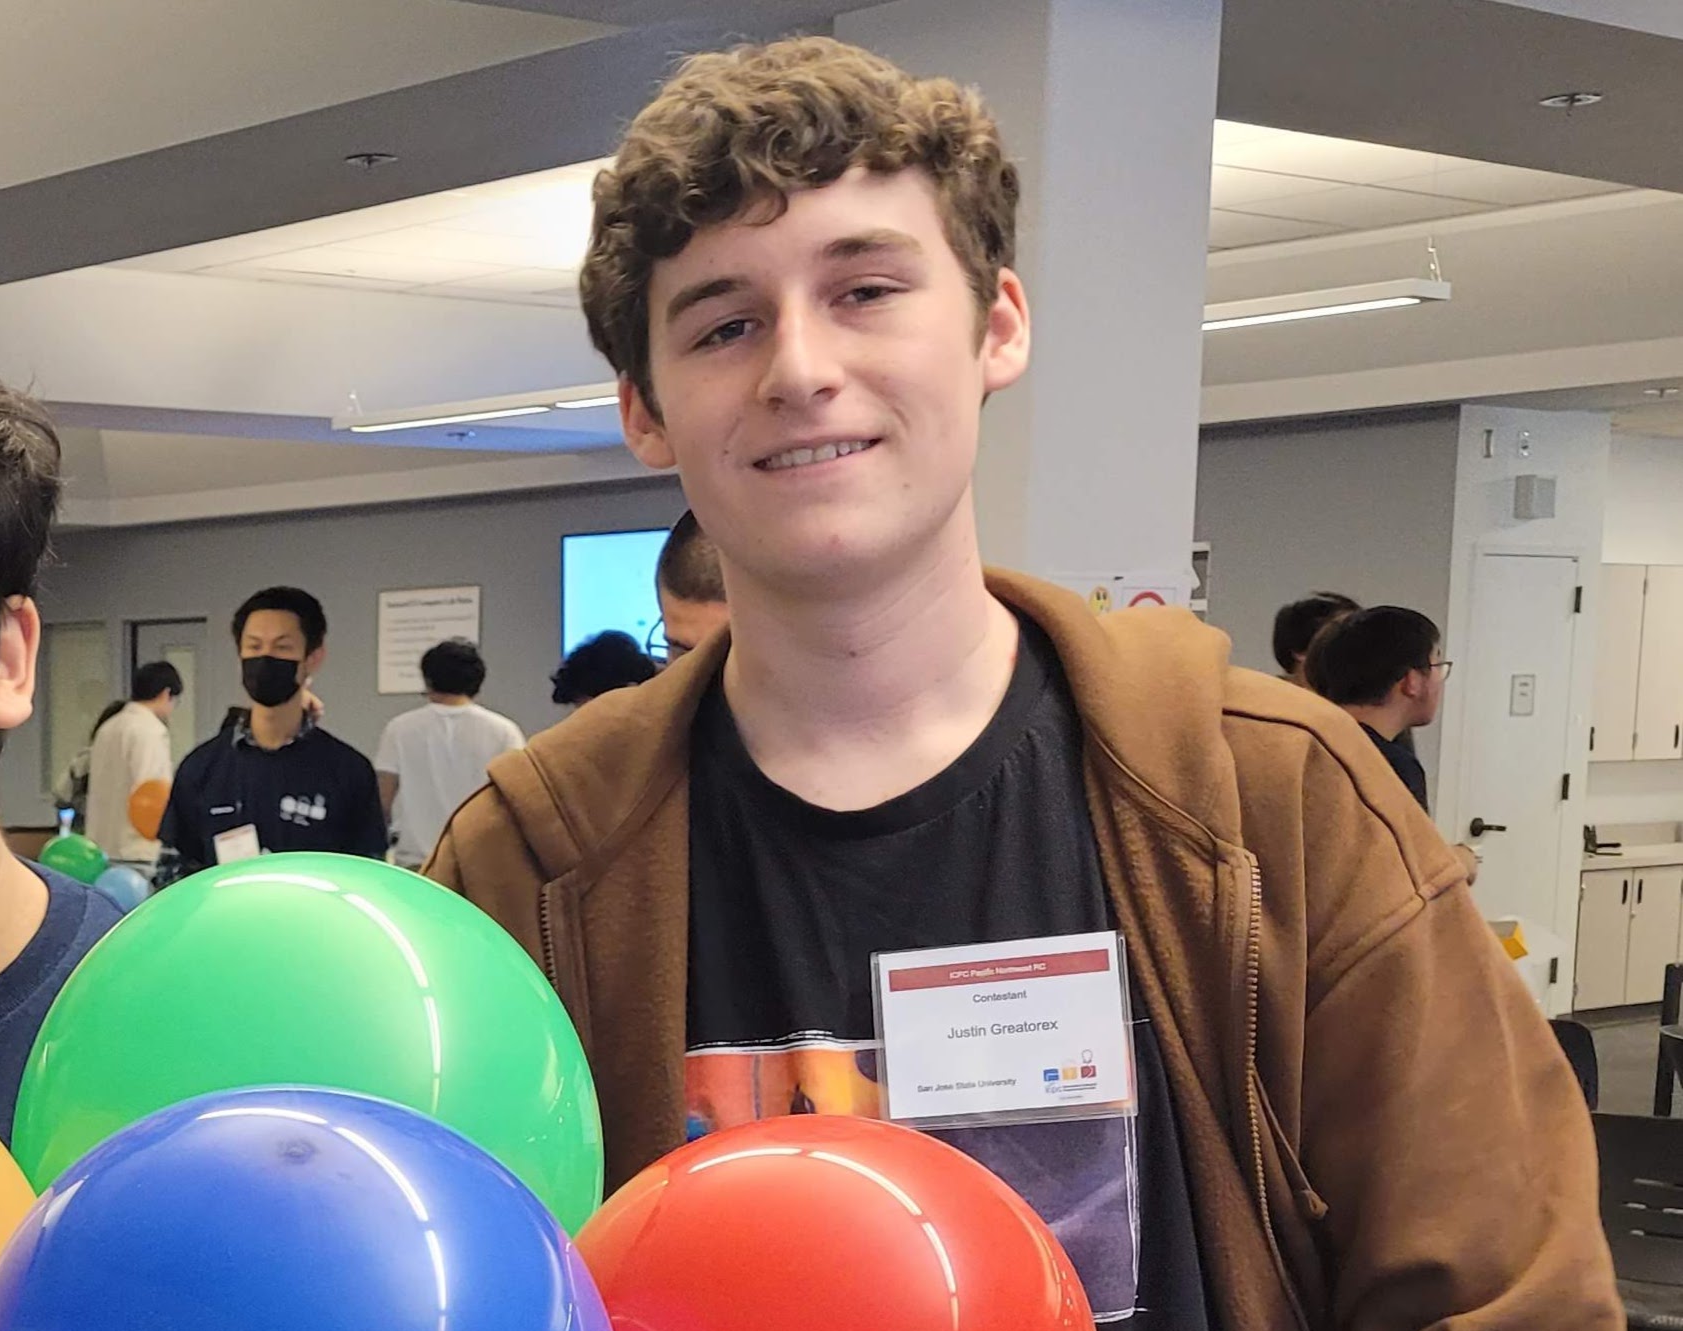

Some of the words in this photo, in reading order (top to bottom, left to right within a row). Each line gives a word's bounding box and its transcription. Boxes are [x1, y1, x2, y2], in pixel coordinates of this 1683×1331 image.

[972, 990, 1027, 1003] Contestant
[947, 1025, 986, 1040] Justin
[990, 1019, 1058, 1035] Greatorex
[917, 1084, 933, 1093] San
[934, 1083, 954, 1092] Jose
[955, 1081, 976, 1091] State
[978, 1077, 1017, 1089] University
